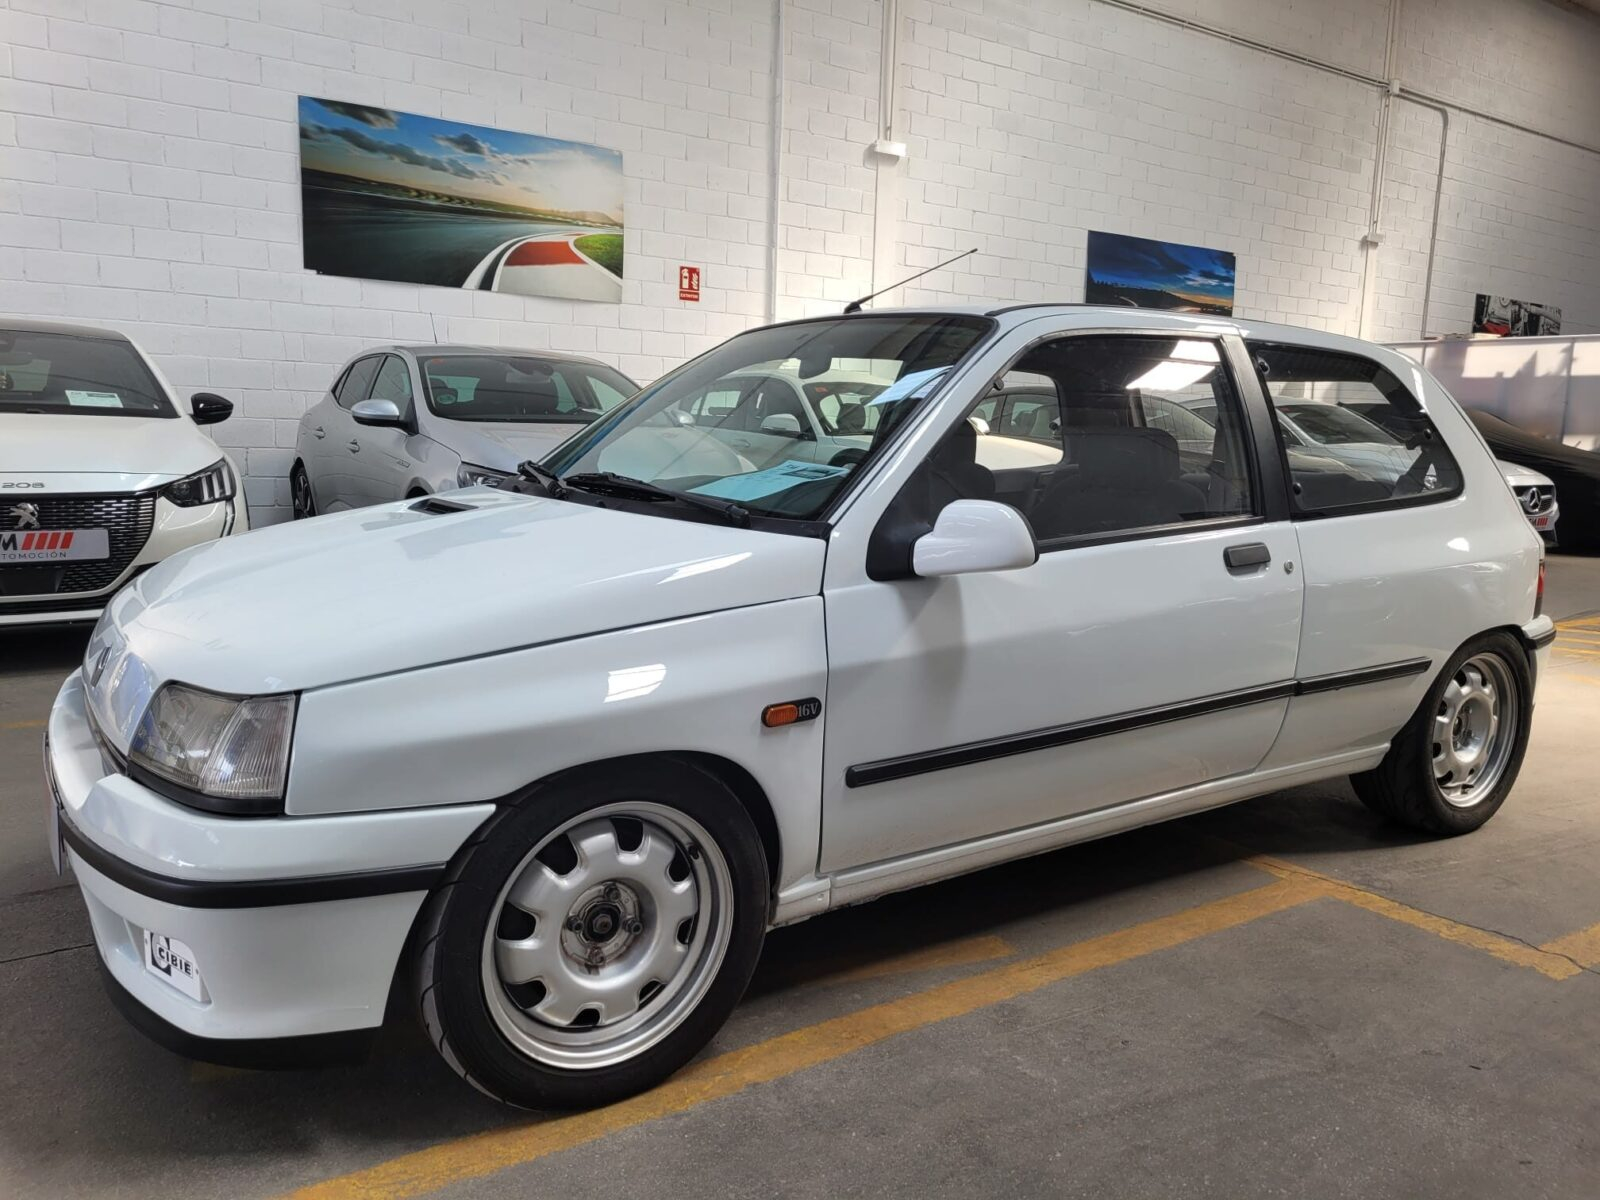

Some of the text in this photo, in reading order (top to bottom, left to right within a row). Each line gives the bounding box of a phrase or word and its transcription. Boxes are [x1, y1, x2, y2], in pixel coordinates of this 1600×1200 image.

[0, 533, 18, 551] M
[798, 702, 819, 717] 16V
[158, 946, 192, 976] CIBIE
